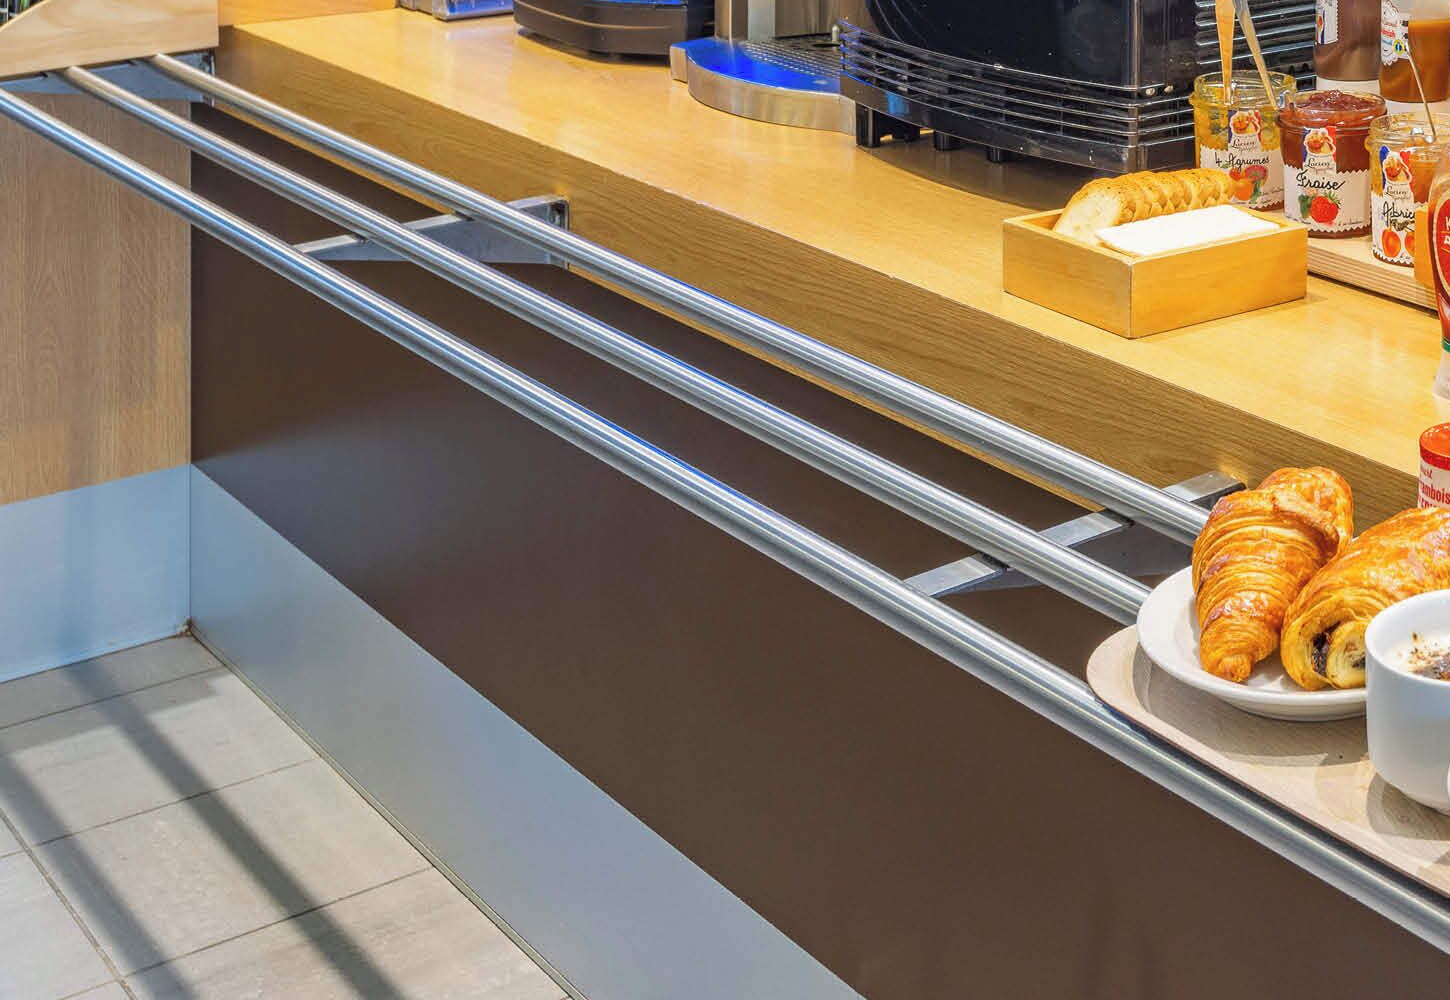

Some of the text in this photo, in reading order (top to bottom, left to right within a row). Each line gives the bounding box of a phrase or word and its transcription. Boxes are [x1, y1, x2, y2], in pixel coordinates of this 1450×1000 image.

[1226, 152, 1270, 173] Agrumes
[1295, 169, 1346, 190] Fraise
[1383, 201, 1415, 227] Abric
